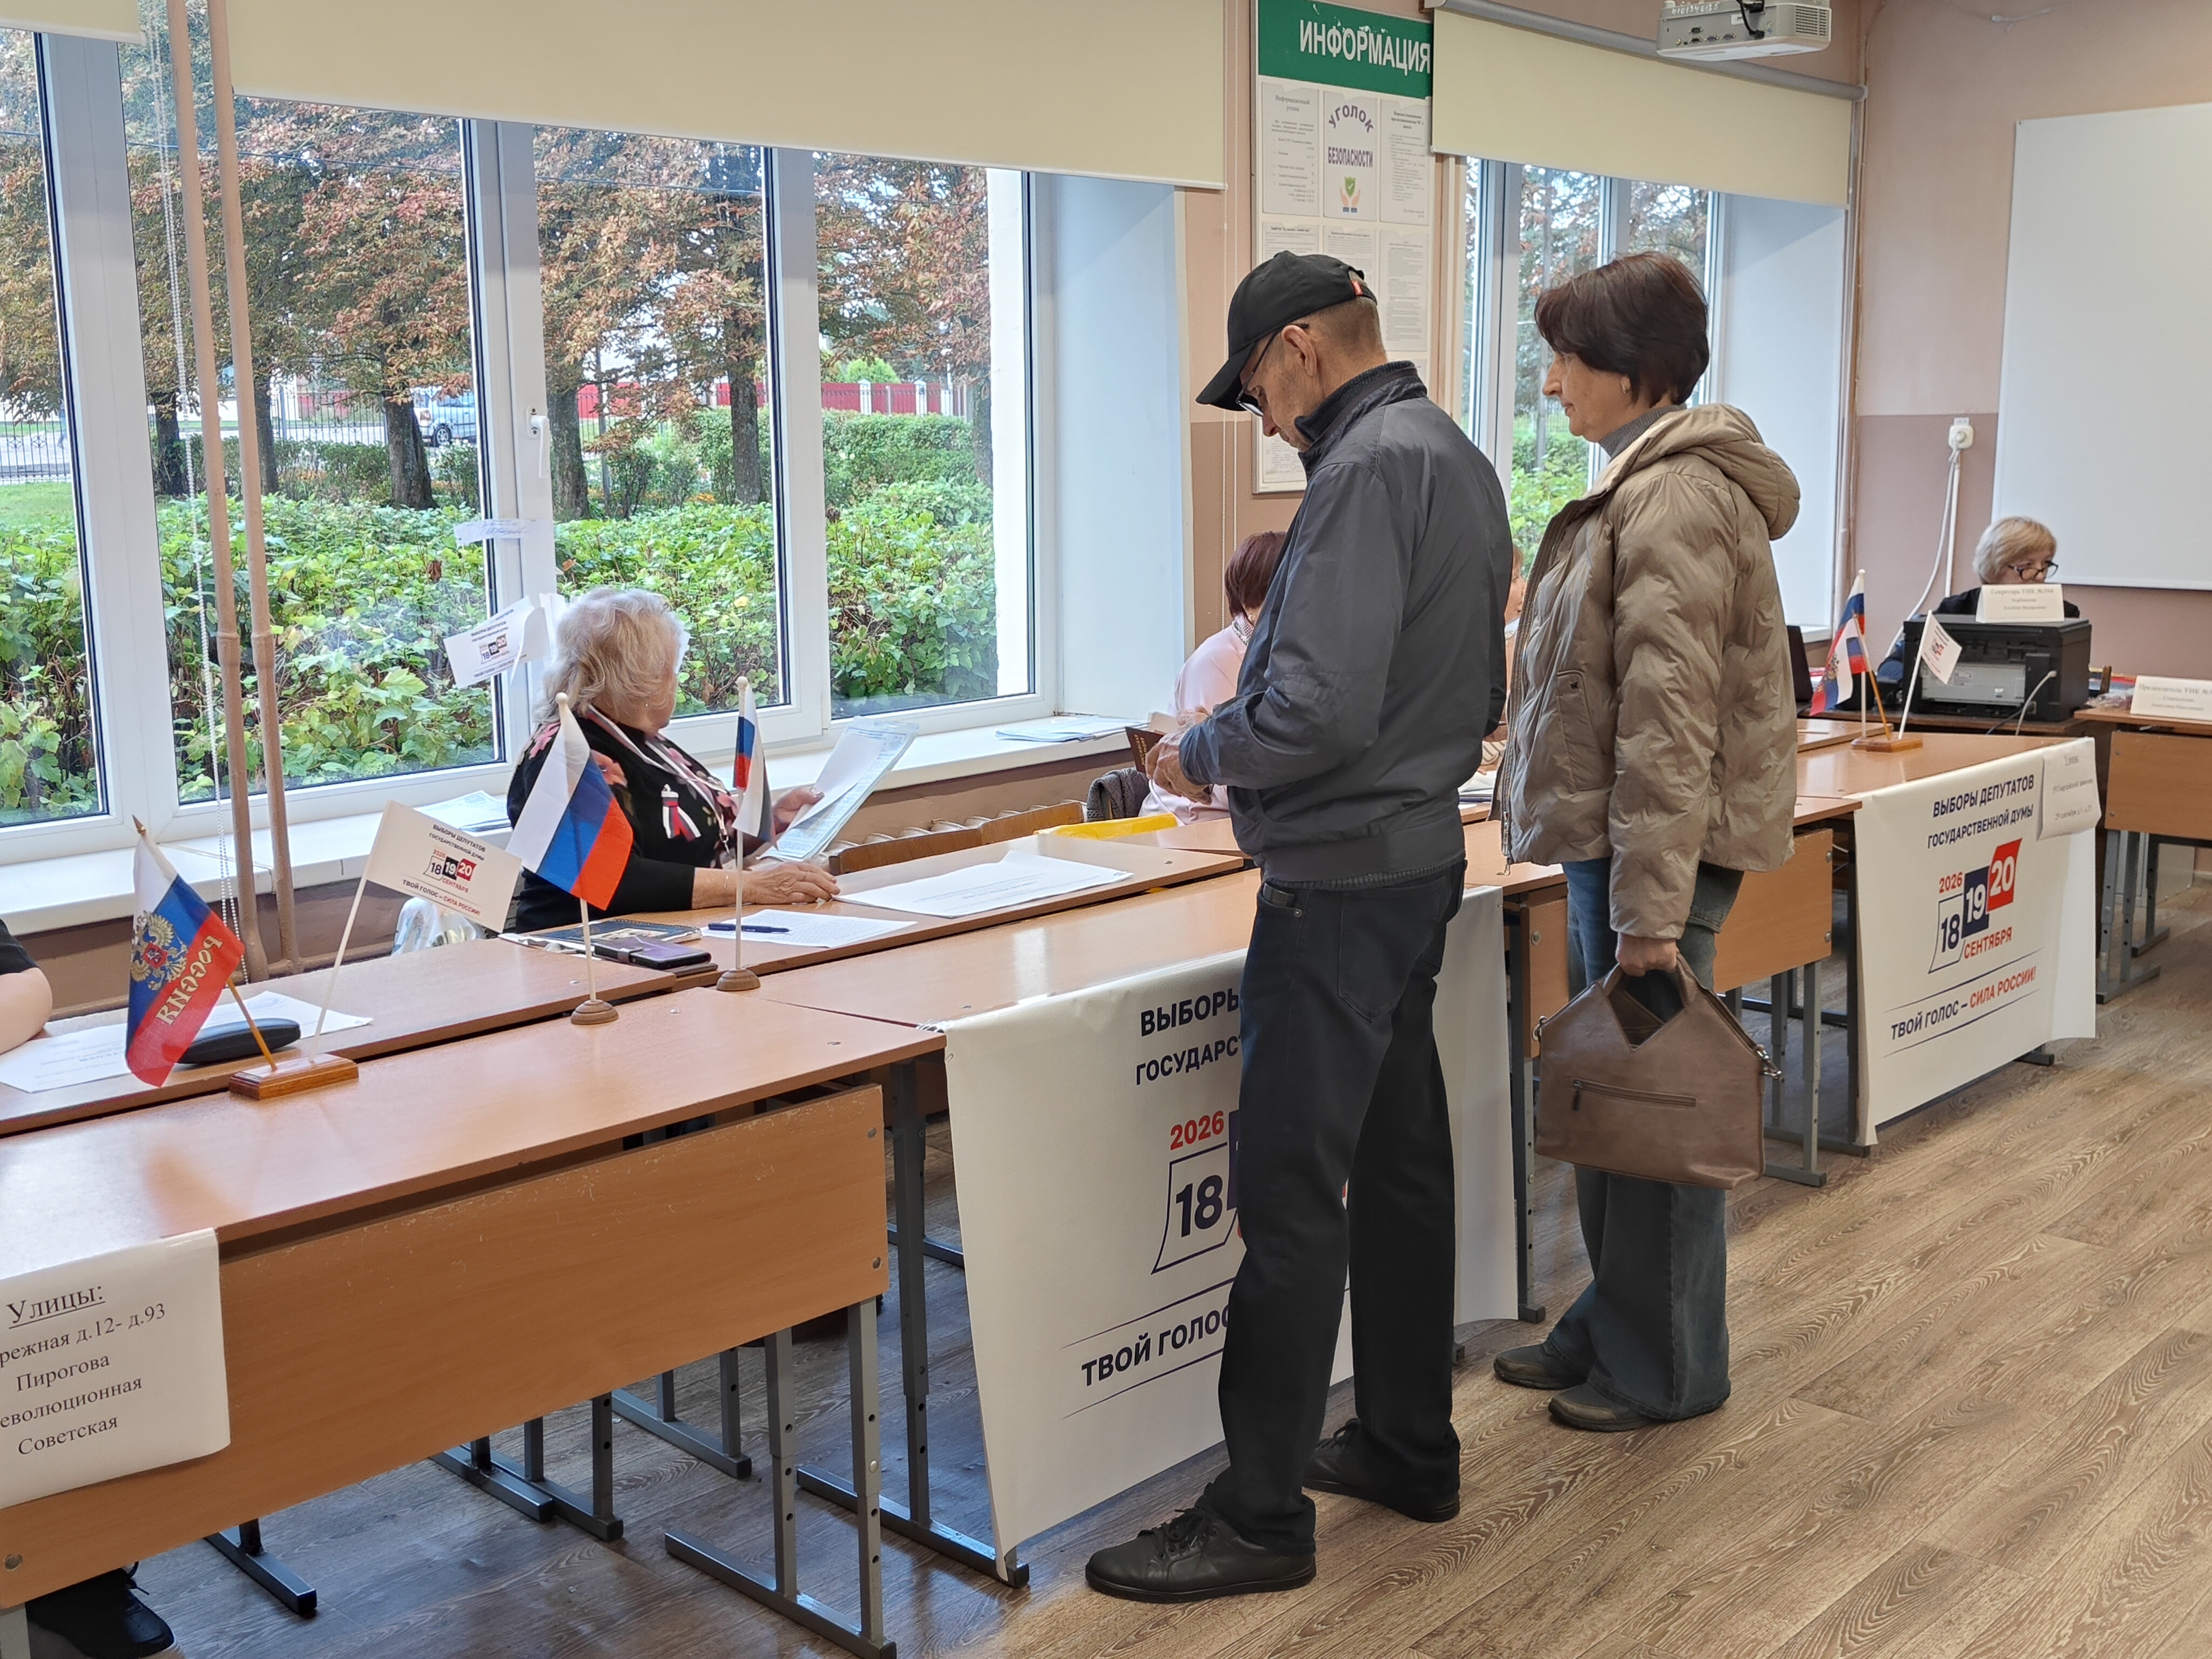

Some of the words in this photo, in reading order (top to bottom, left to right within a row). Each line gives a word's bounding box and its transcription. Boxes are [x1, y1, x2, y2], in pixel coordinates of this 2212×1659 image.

[1300, 19, 1431, 76] ИНФОРМАЦИЯ
[1328, 105, 1374, 133] УГОЛОК
[1328, 146, 1373, 168] БЕЗОПАСНОСТИ
[482, 652, 490, 660] 18
[489, 644, 497, 653] 19
[497, 637, 506, 646] 20
[1933, 790, 1979, 818] ВЫБОРЫ
[1979, 774, 2034, 807] ДЕПУТАТОВ
[433, 824, 456, 839] ВЫБОРЫ
[456, 835, 486, 852] ДЕПУТАТОВ
[1927, 808, 2009, 849] ГОСУДАРСТВЕННОЙ
[2010, 804, 2034, 825] ДУМЫ
[431, 862, 442, 875] 18
[444, 862, 457, 875] 19
[457, 862, 473, 876] 20
[1939, 872, 1963, 893] 2026
[402, 879, 419, 890] ТВОЙ
[419, 887, 439, 898] ГОЛОС
[443, 895, 457, 906] СИЛА
[1941, 914, 1960, 953] 18
[1966, 884, 1987, 923] 19
[1989, 855, 2015, 897] 20
[1964, 927, 2012, 959] СЕНТЯБРЯ
[1891, 1011, 1923, 1040] ТВОЙ
[1925, 1000, 1959, 1028] ГОЛОС
[1970, 984, 1995, 1008] СИЛА
[1997, 966, 2036, 996] РОССИИ!
[1137, 1034, 1240, 1085] ГОСУДАРС
[1170, 1110, 1224, 1151] 2026
[1176, 1175, 1223, 1238] 18
[6, 1286, 103, 1324] Улицы:
[128, 1303, 165, 1330] д.93
[16, 1355, 110, 1392] Пирогова
[1081, 1332, 1151, 1387] ТВОЙ
[0, 1378, 142, 1428] еволюционная
[18, 1417, 118, 1455] Советская
